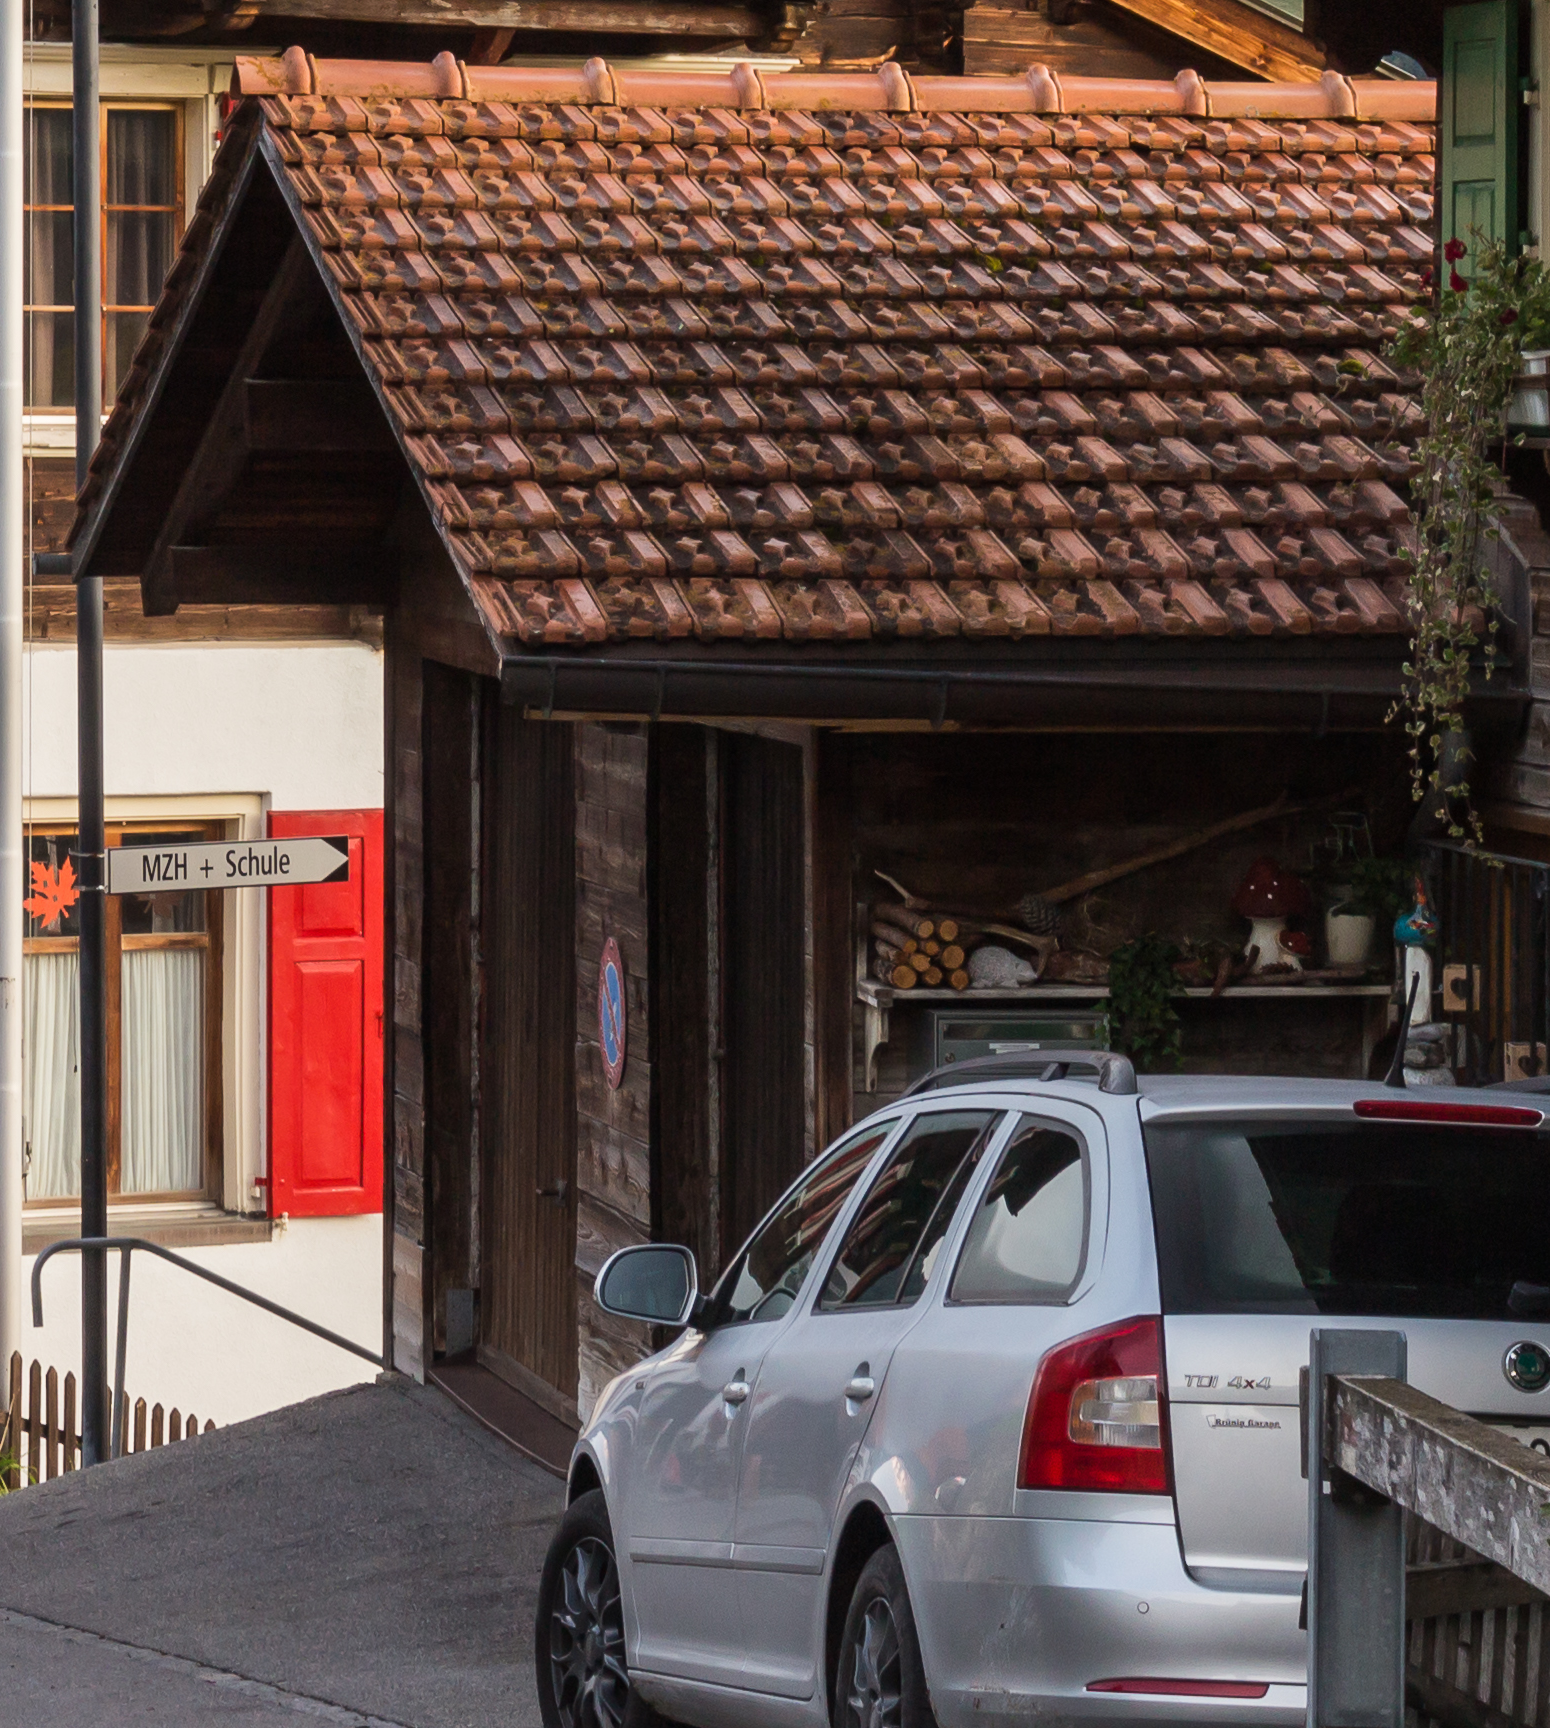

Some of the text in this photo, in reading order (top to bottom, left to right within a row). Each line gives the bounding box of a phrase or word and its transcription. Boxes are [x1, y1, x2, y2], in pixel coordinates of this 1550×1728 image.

[142, 845, 291, 883] MZH + Schule
[1184, 1374, 1271, 1391] TDI 4x4
